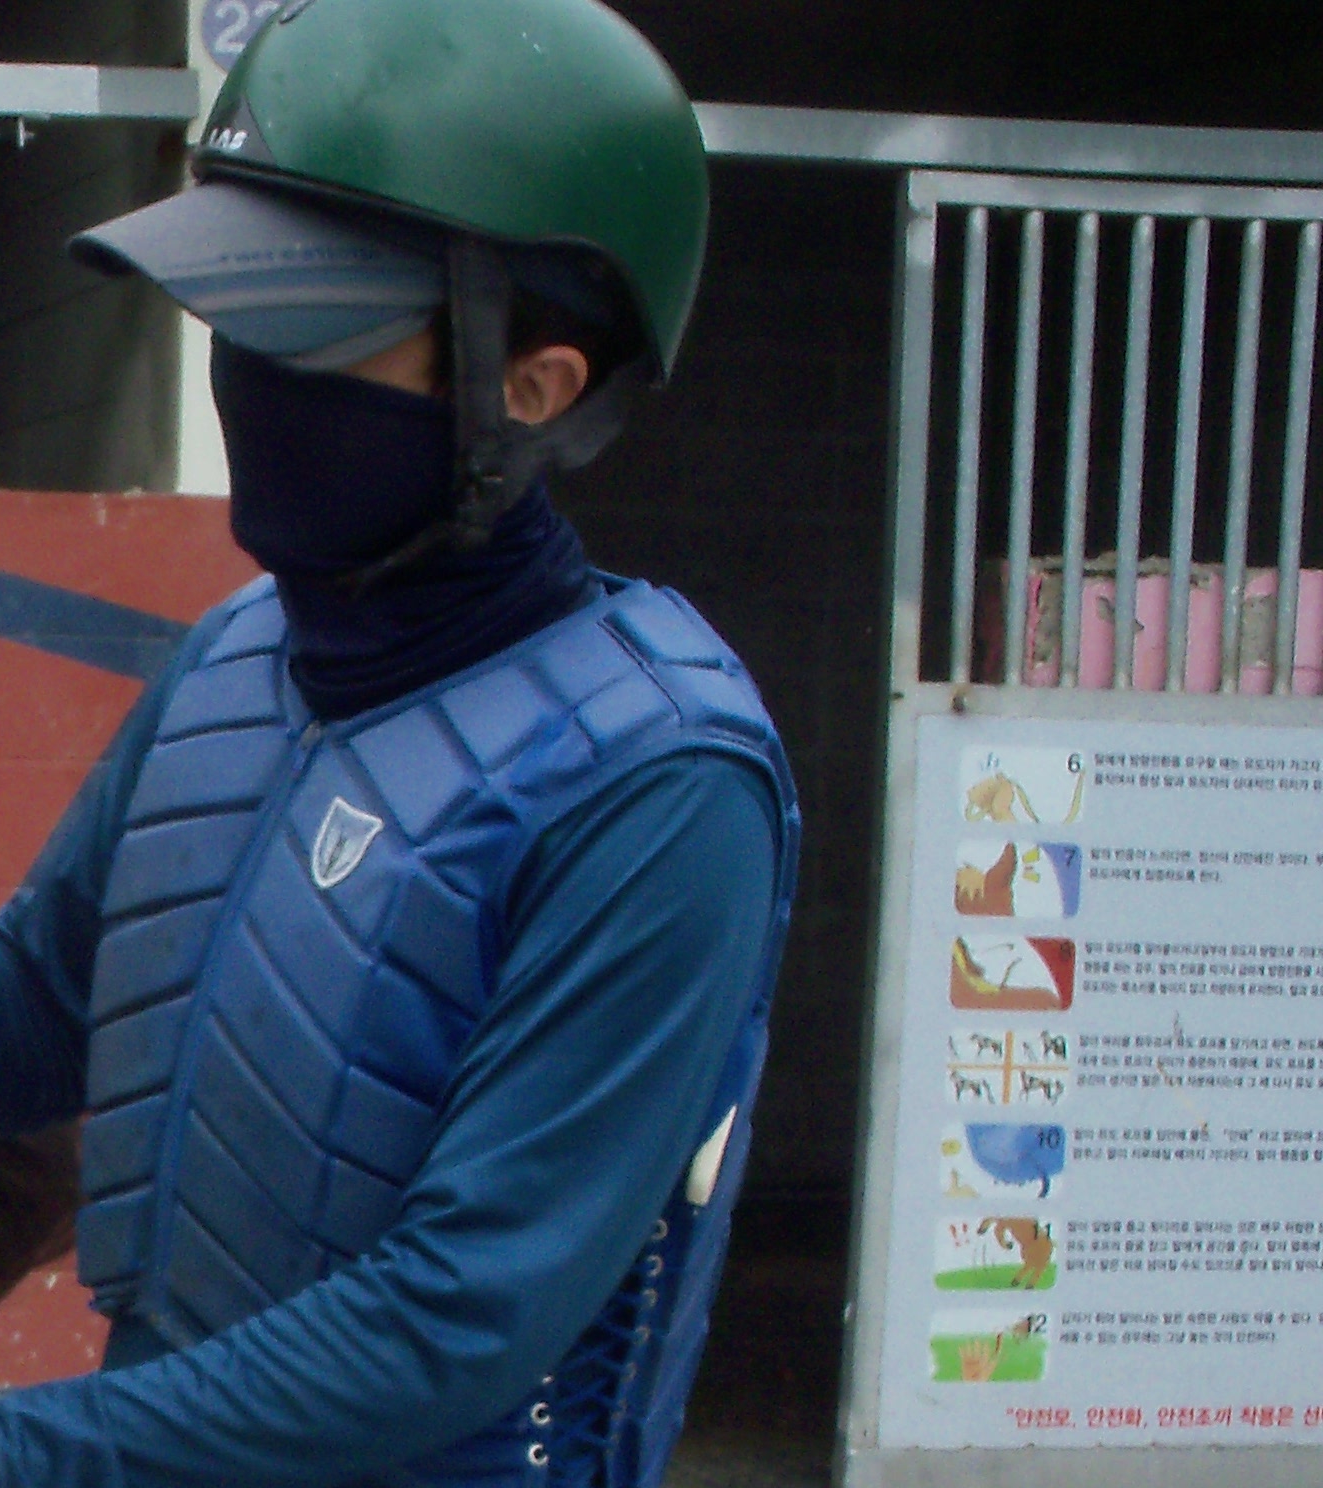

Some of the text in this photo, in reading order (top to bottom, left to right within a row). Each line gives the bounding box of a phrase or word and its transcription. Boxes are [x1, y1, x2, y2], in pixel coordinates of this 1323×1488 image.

[1068, 753, 1081, 773] 6
[1064, 846, 1076, 867] 7
[1037, 1126, 1060, 1149] 10
[1026, 1313, 1047, 1333] 12
